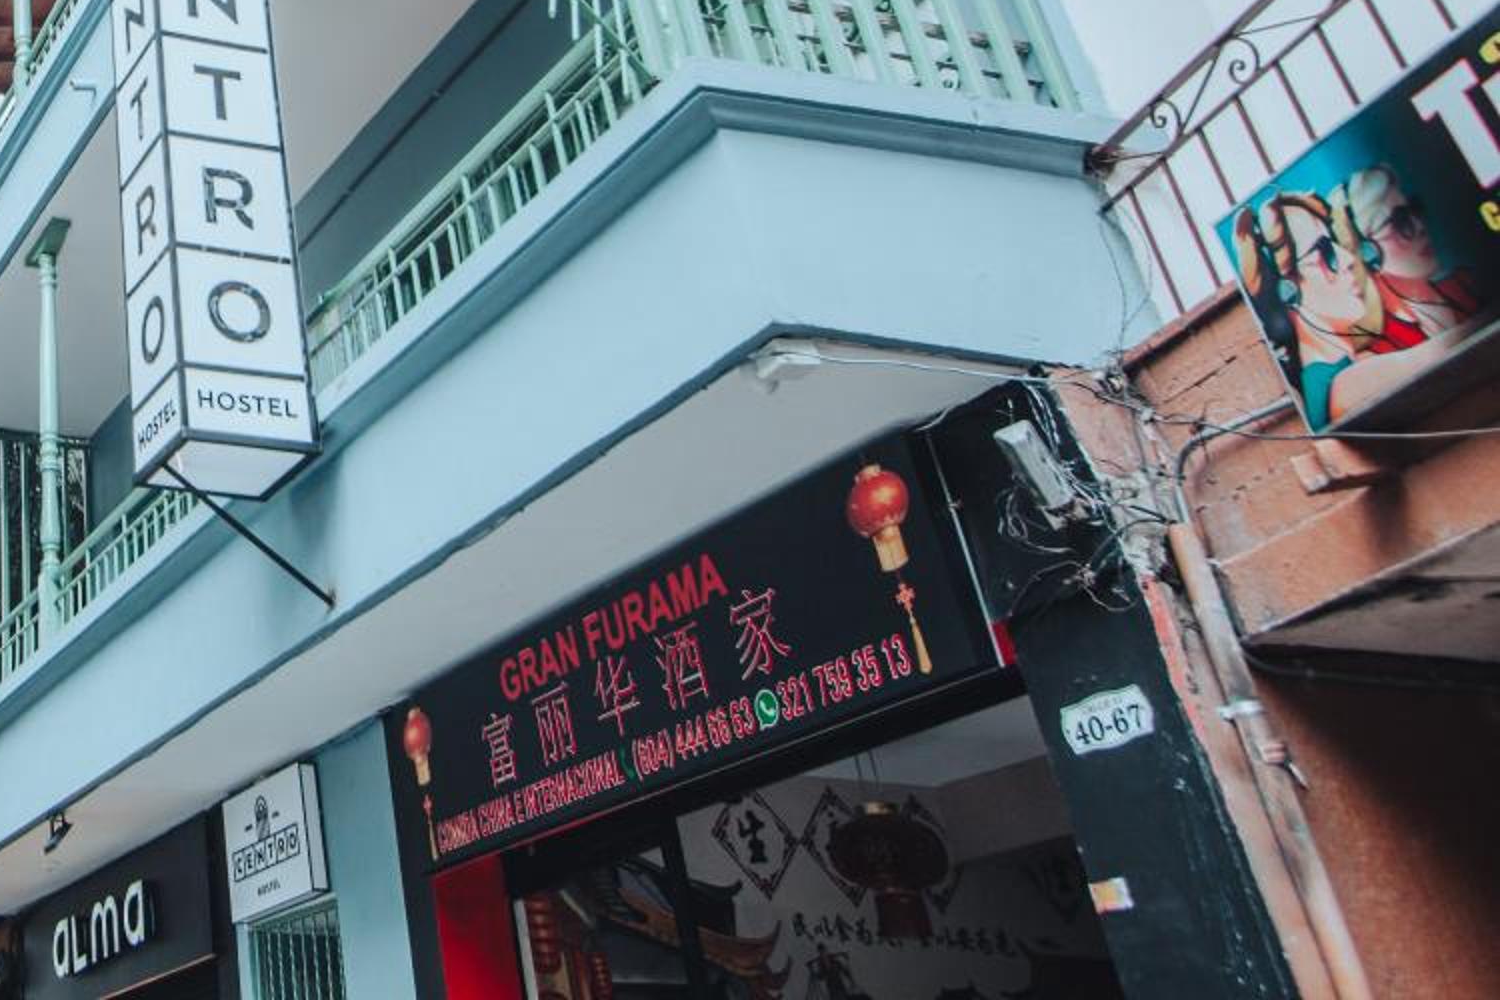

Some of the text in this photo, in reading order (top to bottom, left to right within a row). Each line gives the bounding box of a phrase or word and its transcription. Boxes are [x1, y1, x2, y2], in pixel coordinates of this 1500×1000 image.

[1411, 57, 1500, 189] T
[137, 399, 177, 450] HOSTEL
[197, 388, 298, 419] HOSTEL
[500, 552, 729, 700] GRAN FURAMA
[482, 586, 792, 788] 富丽华酒家
[675, 715, 708, 760] 444
[775, 672, 816, 721] 321
[812, 656, 854, 707] 759
[852, 644, 884, 691] 35
[880, 633, 913, 680] 13
[1075, 703, 1141, 745] 40-67
[235, 831, 299, 876] CENTRO
